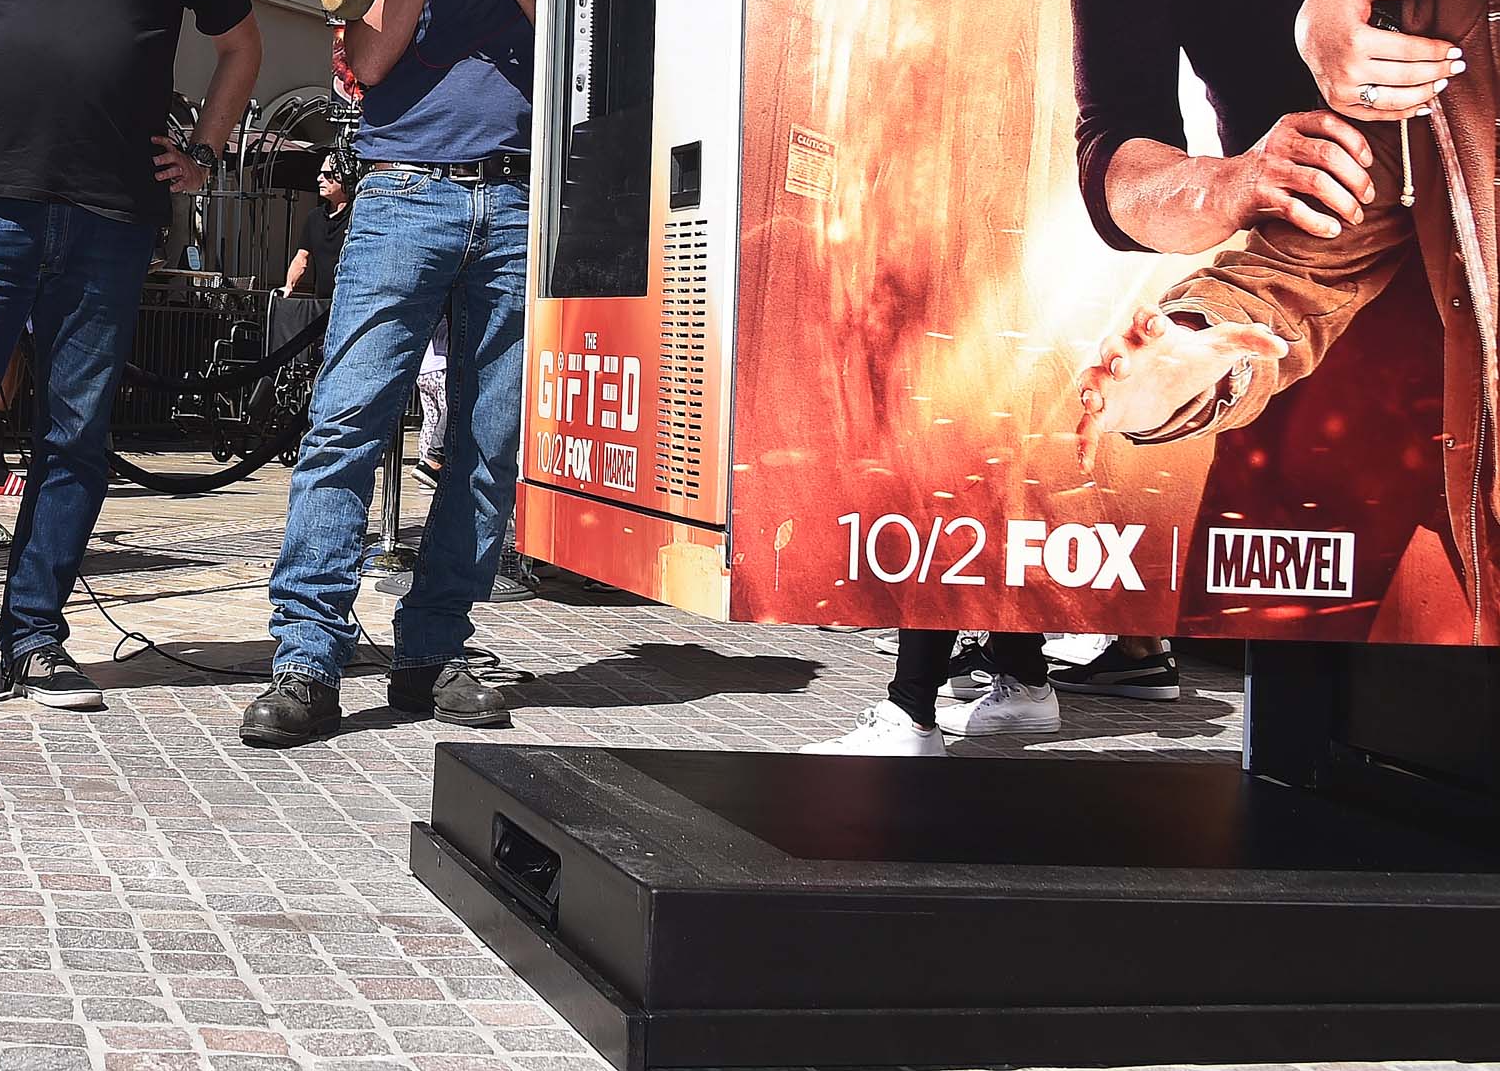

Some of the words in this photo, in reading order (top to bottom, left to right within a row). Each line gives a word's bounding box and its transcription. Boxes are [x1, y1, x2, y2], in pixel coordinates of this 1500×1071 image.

[584, 332, 598, 350] THE
[537, 431, 563, 476] 10/2
[564, 435, 594, 483] FOX
[604, 444, 636, 489] MARVEL
[837, 512, 987, 586] 10/2
[1005, 519, 1147, 591] FOX
[1212, 532, 1348, 592] MARVEL
